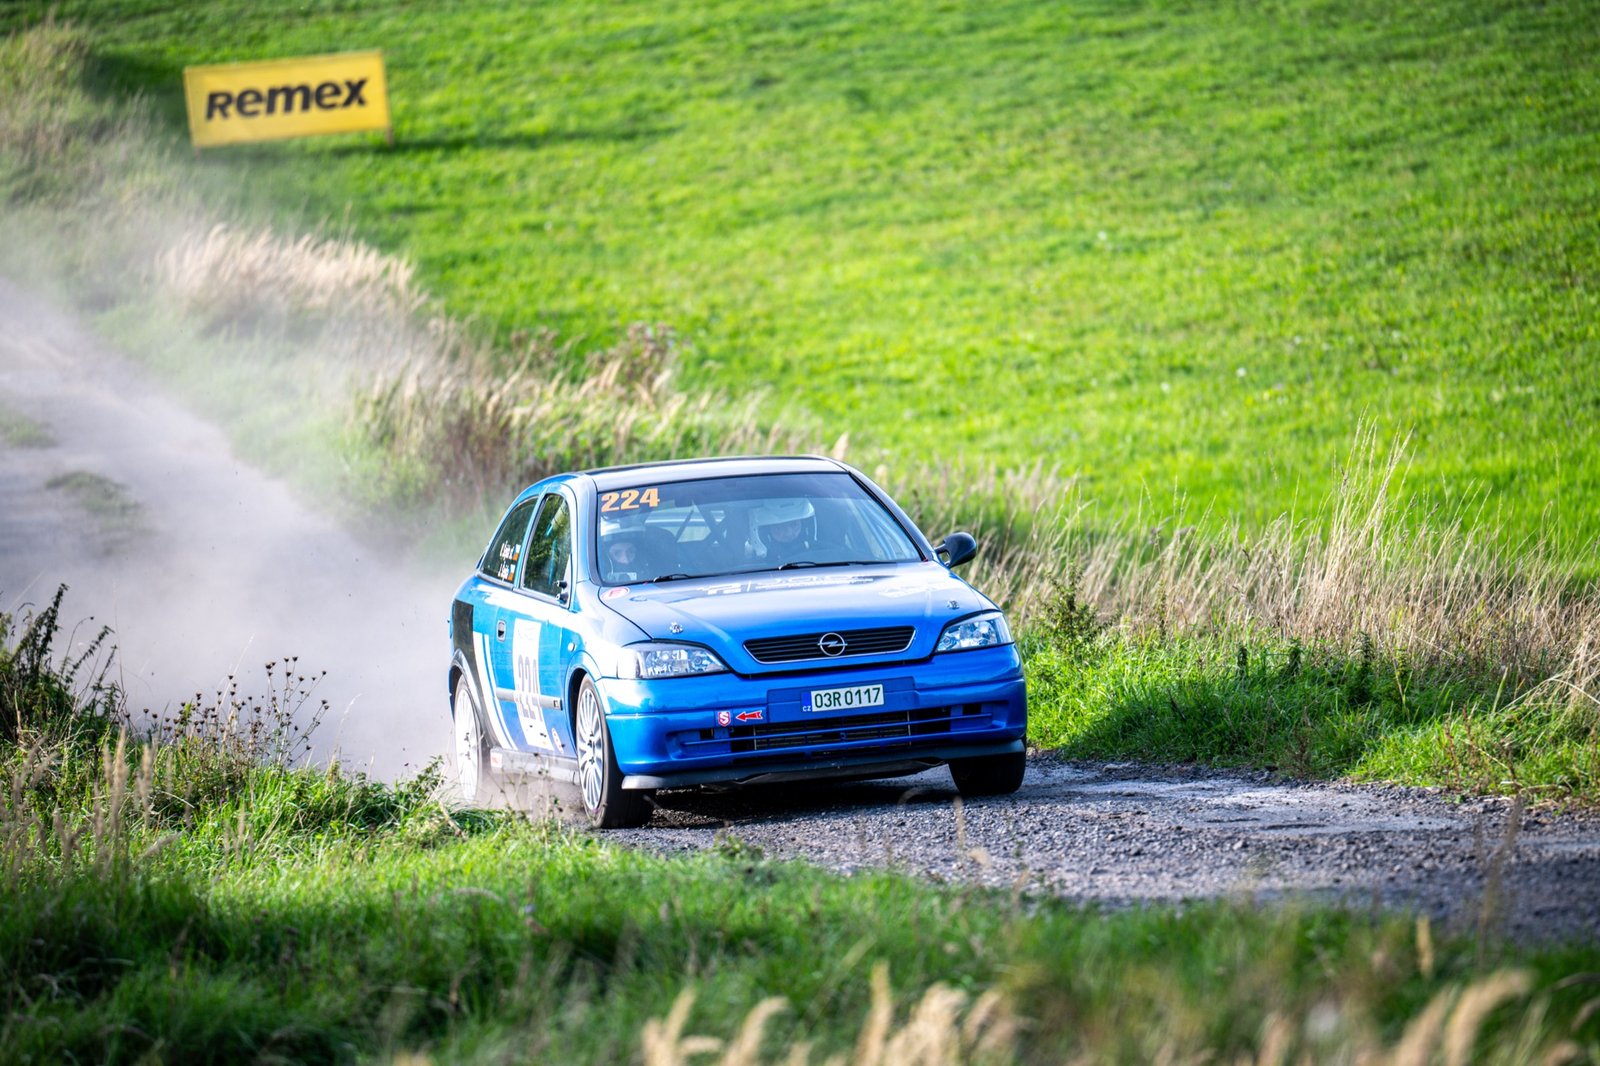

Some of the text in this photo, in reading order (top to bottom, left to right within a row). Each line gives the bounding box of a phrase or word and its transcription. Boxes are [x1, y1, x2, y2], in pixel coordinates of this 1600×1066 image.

[206, 77, 368, 121] Remex
[601, 487, 660, 512] 224
[517, 654, 543, 722] 224
[814, 687, 881, 709] 03R 0117
